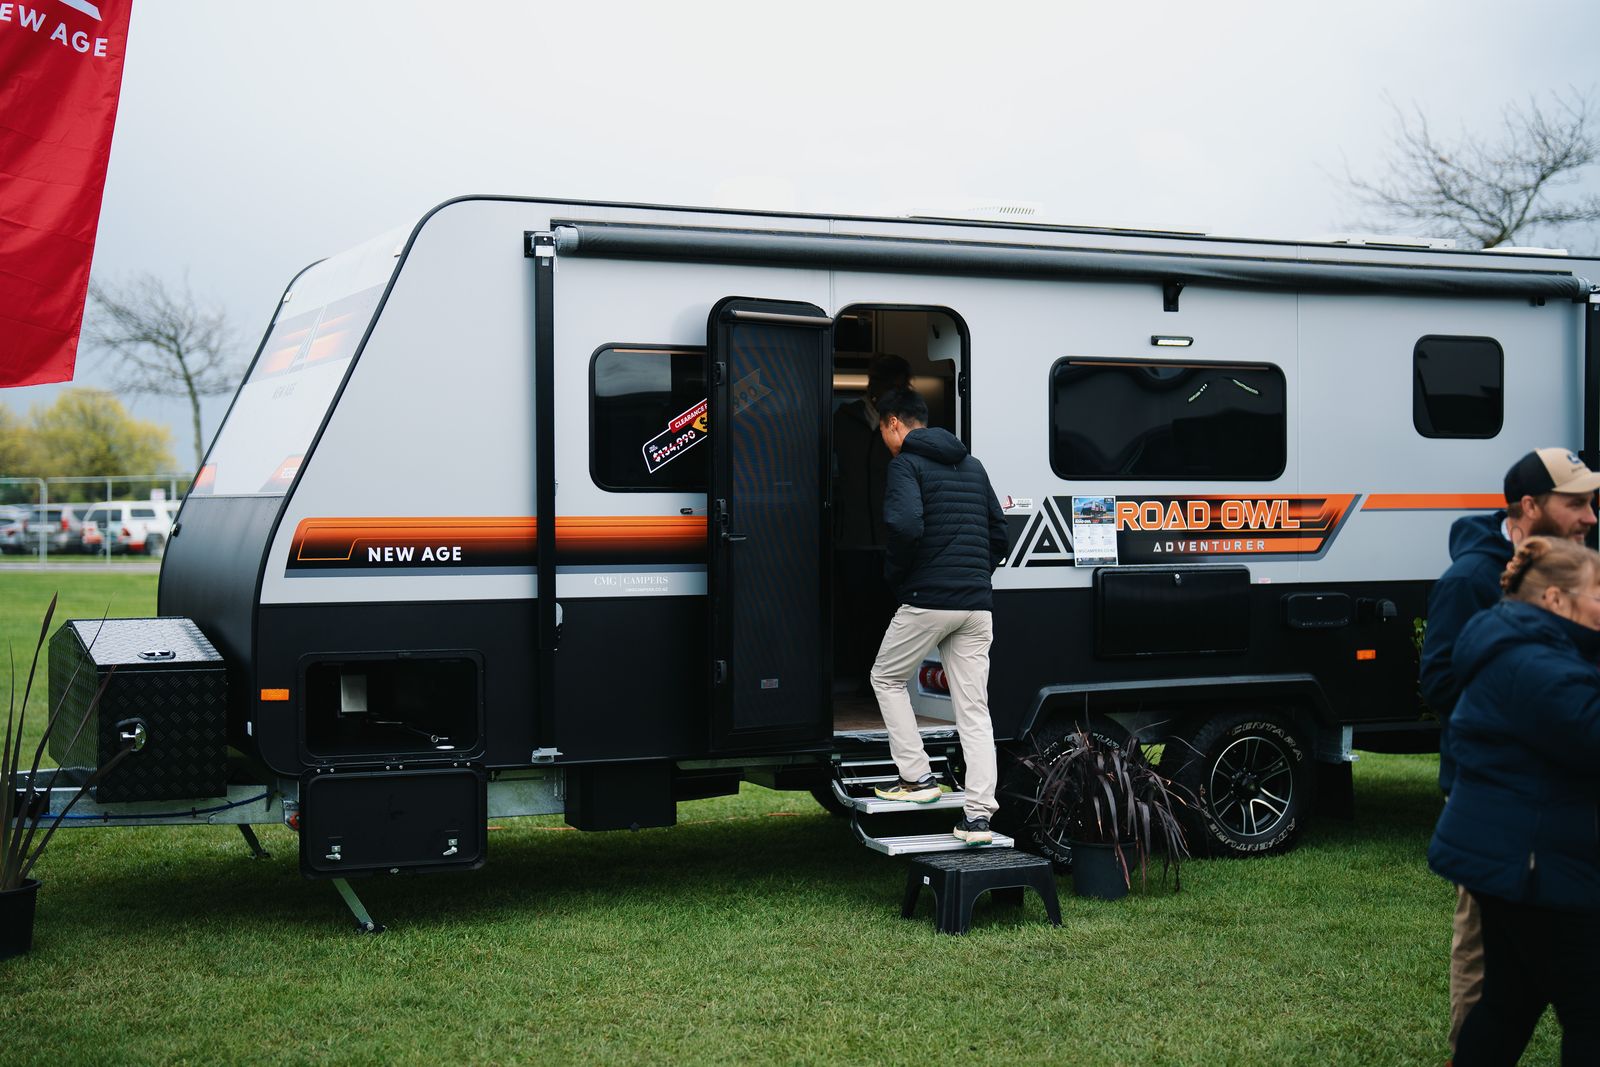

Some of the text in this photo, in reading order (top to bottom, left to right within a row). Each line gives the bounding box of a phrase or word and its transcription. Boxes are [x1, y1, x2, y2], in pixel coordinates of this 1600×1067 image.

[0, 3, 108, 57] EW AGE
[674, 405, 704, 428] CLEARANCE
[653, 430, 696, 462] $134,990
[1116, 500, 1300, 531] ROAD OWL
[368, 546, 462, 562] NEW AGE
[1153, 540, 1266, 553] ADVENTURER
[594, 575, 669, 585] CMG CAMPERS
